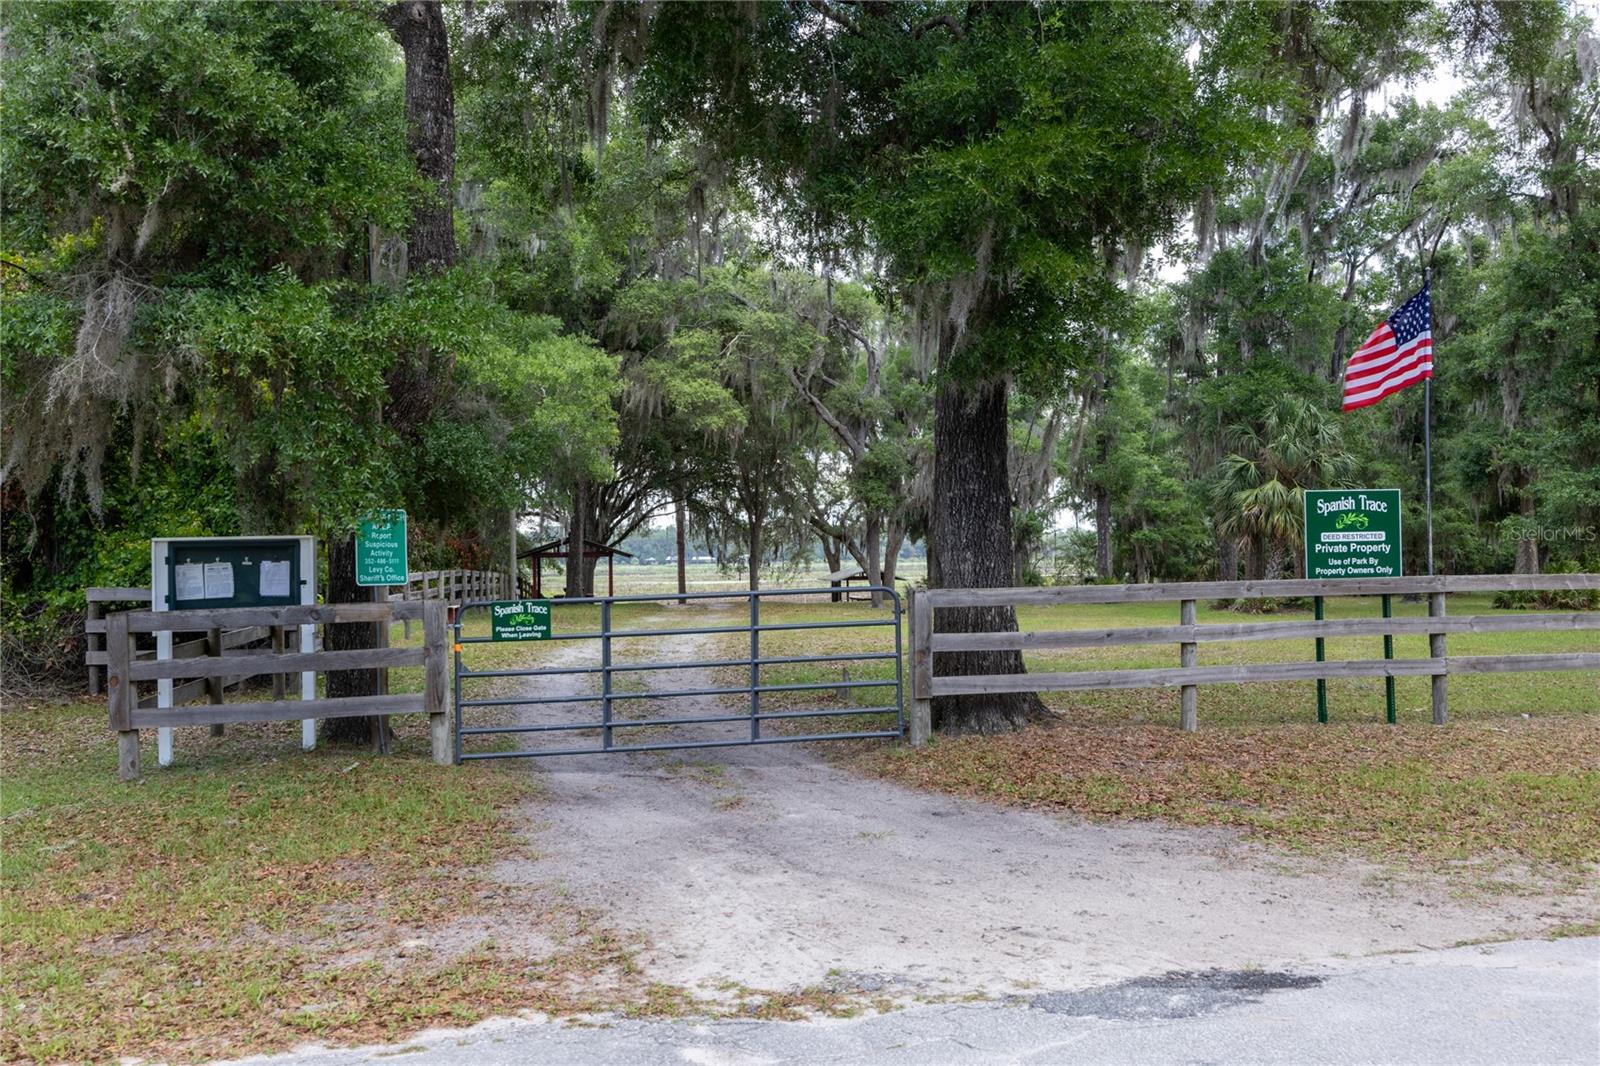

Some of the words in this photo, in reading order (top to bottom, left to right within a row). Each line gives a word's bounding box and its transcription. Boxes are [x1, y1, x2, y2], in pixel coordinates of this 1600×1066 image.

[1317, 496, 1355, 516] Spanish
[1359, 495, 1387, 512] Trace
[1315, 544, 1348, 553] Private
[1350, 543, 1391, 554] Property
[1368, 558, 1379, 566] By
[1376, 566, 1393, 574] Only
[494, 602, 524, 618] Spanish
[526, 602, 548, 614] Trace
